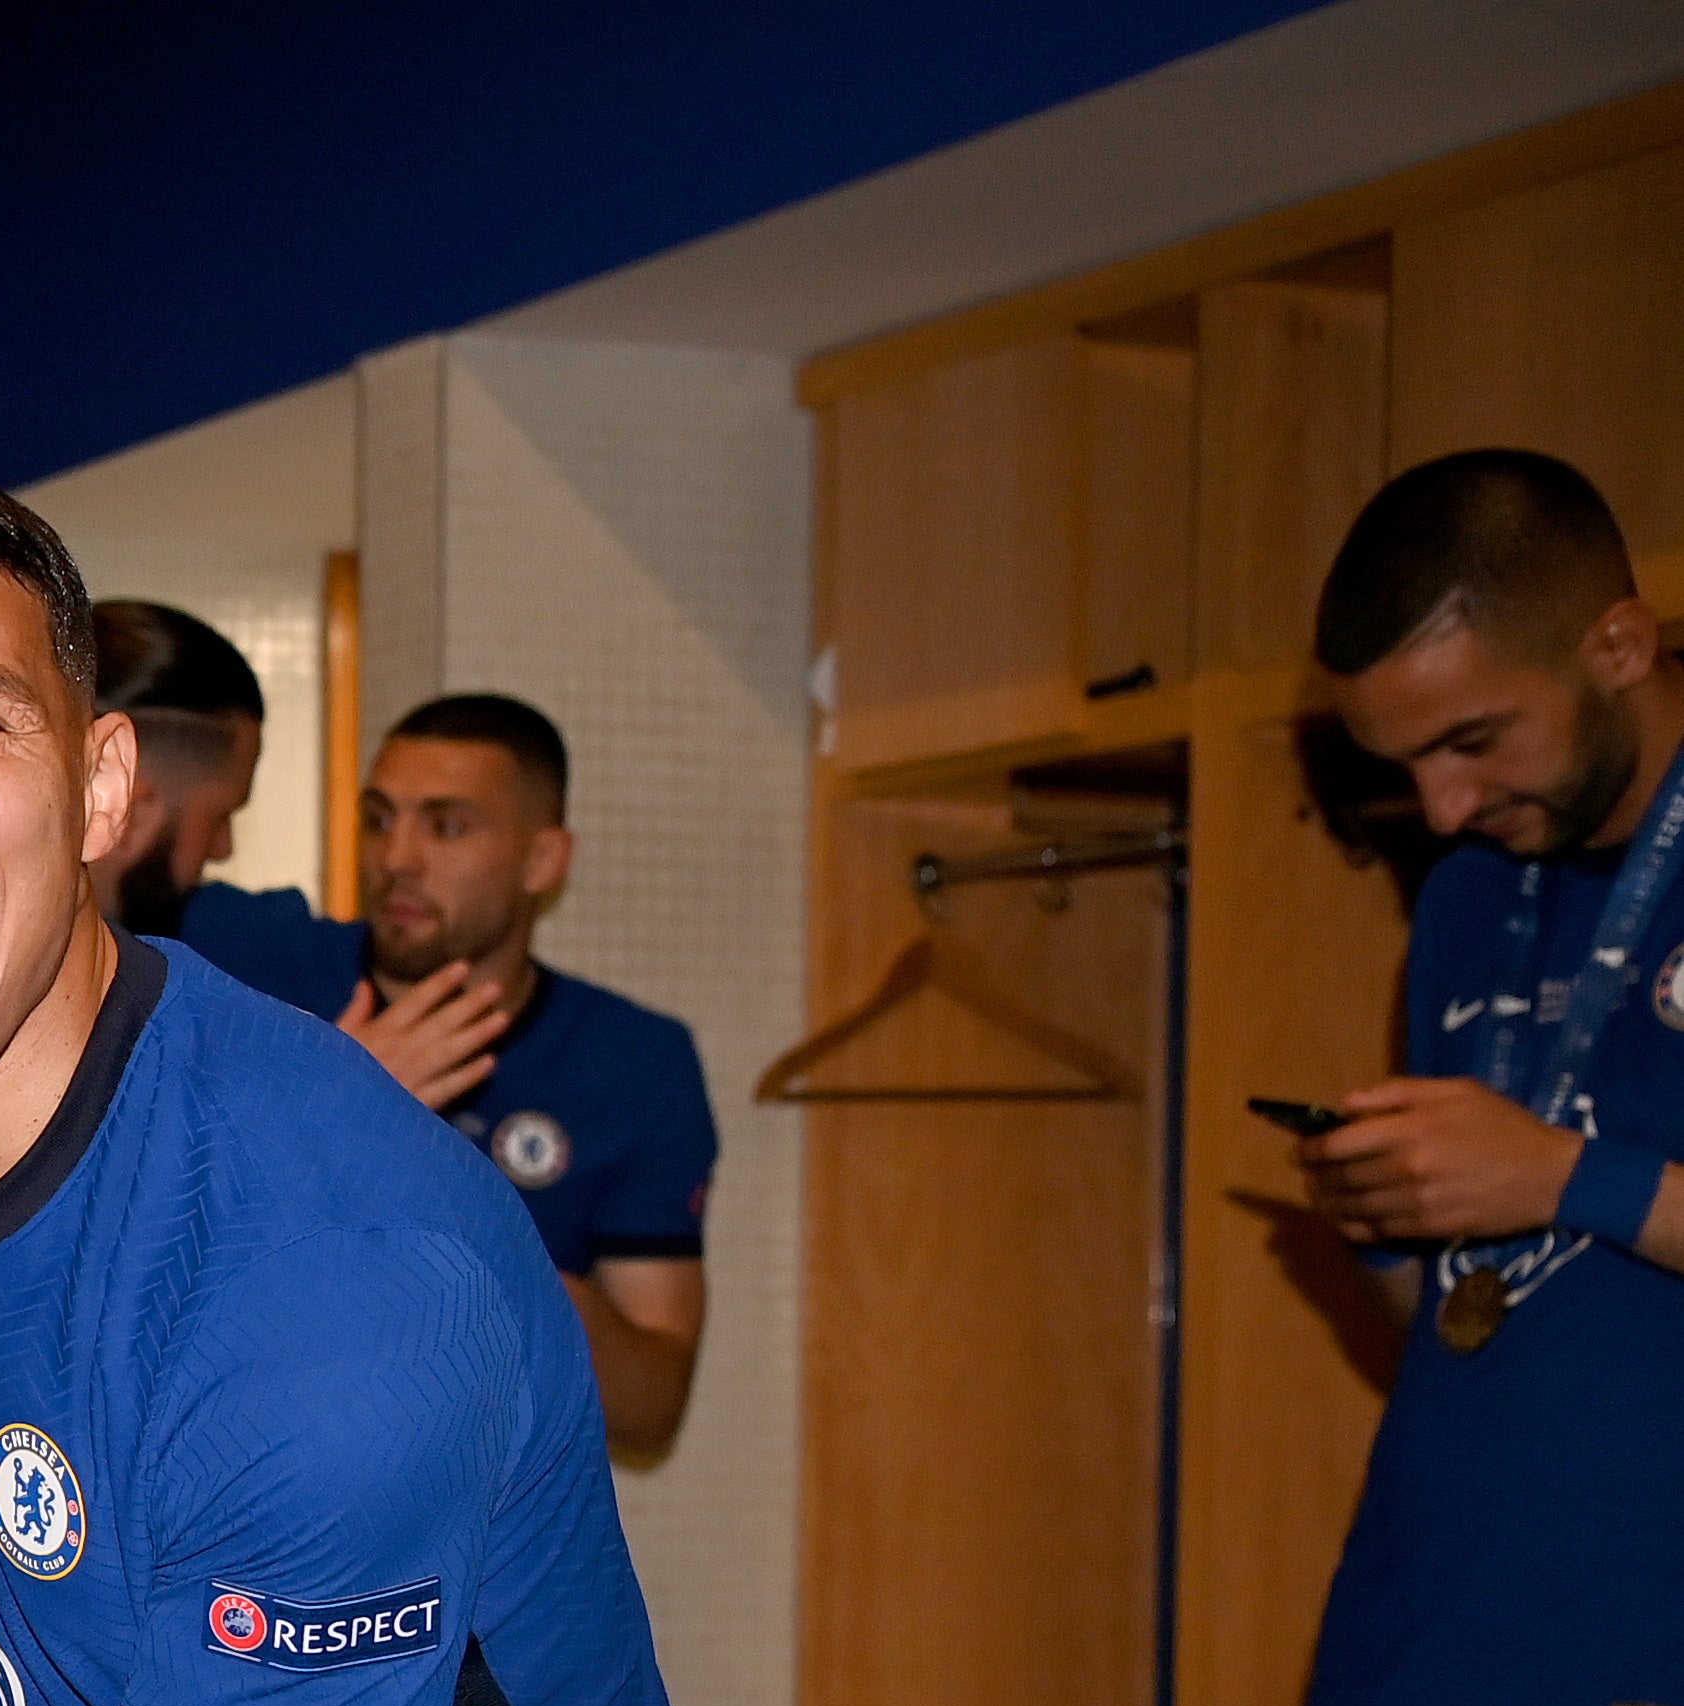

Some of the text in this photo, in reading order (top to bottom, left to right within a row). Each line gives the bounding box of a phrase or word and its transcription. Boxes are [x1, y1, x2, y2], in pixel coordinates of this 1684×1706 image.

[1, 1430, 66, 1481] CHELSEA
[42, 1555, 66, 1572] CLUB
[220, 1597, 256, 1616] UEFA
[272, 1598, 440, 1655] RESPECT
